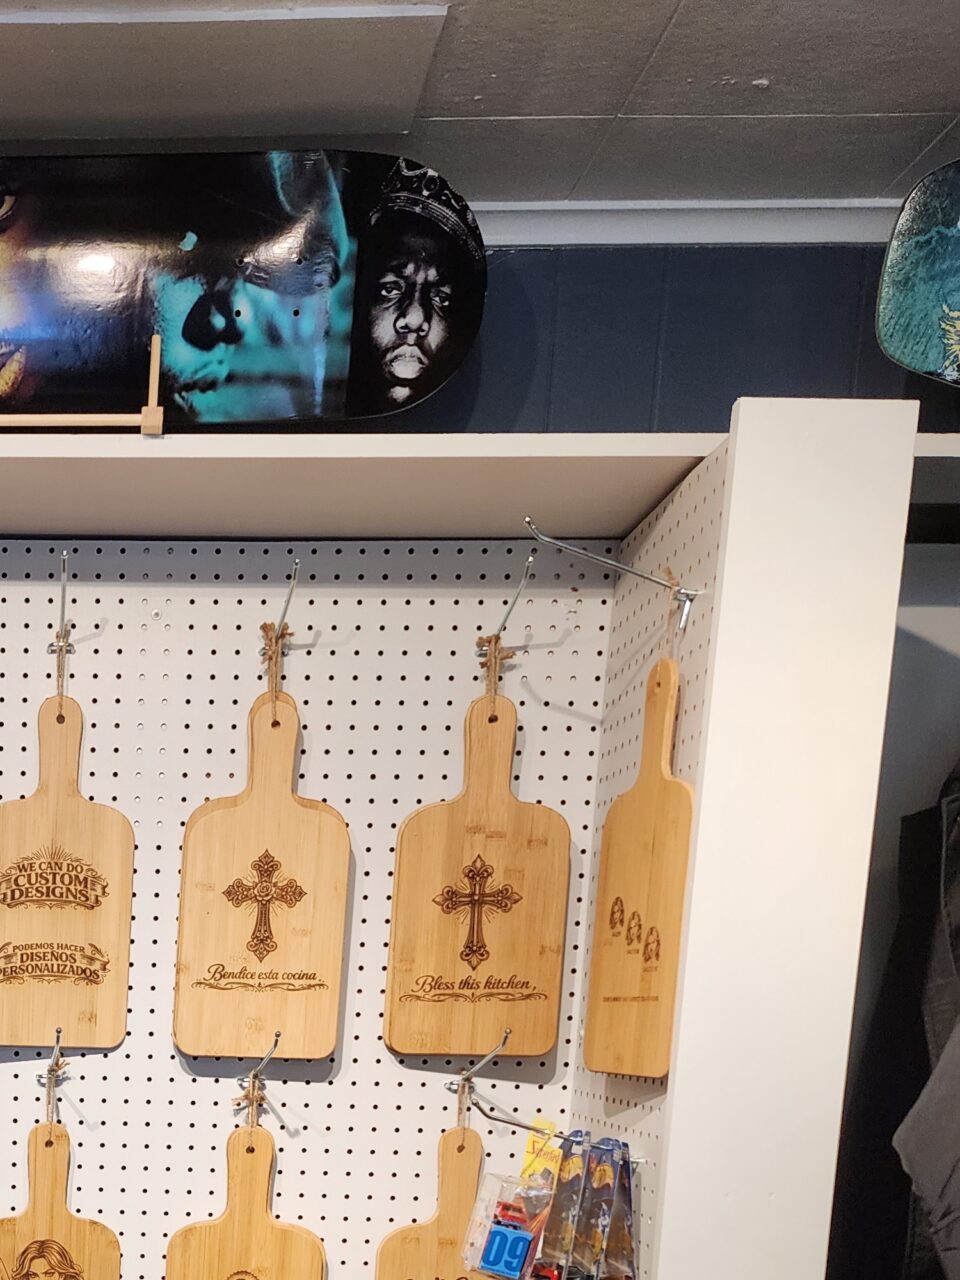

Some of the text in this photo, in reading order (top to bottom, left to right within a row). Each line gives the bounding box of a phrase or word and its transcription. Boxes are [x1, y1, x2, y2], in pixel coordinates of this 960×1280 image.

[17, 861, 84, 874] WE CAN DO
[14, 872, 89, 889] CUSTOM
[10, 886, 90, 902] DESIGNS
[13, 943, 85, 953] PODEMOS HACER
[20, 950, 77, 964] DISEÑOS
[203, 964, 256, 981] Bendice
[258, 969, 279, 980] esta
[411, 975, 456, 993] Bless
[458, 975, 481, 990] this
[482, 1230, 530, 1273] 09
